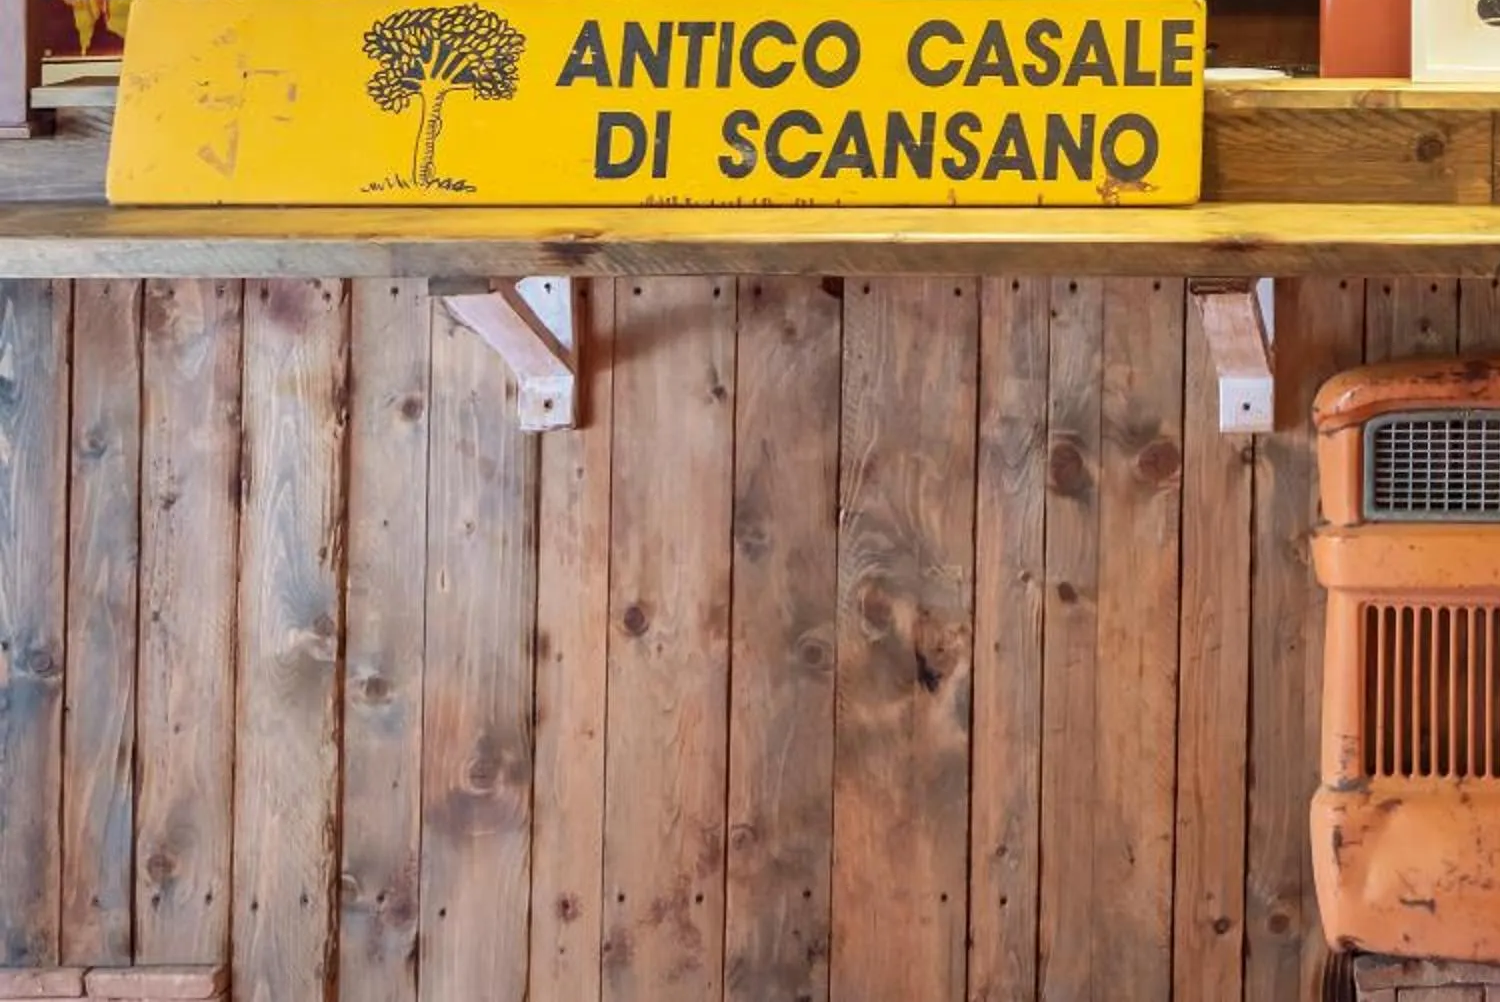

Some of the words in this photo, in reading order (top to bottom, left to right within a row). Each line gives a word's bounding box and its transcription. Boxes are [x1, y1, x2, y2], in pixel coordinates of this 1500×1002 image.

[556, 18, 860, 89] ANTICO
[907, 18, 1196, 89] CASALE
[594, 111, 670, 179] DI
[718, 108, 1159, 182] SCANSANO
